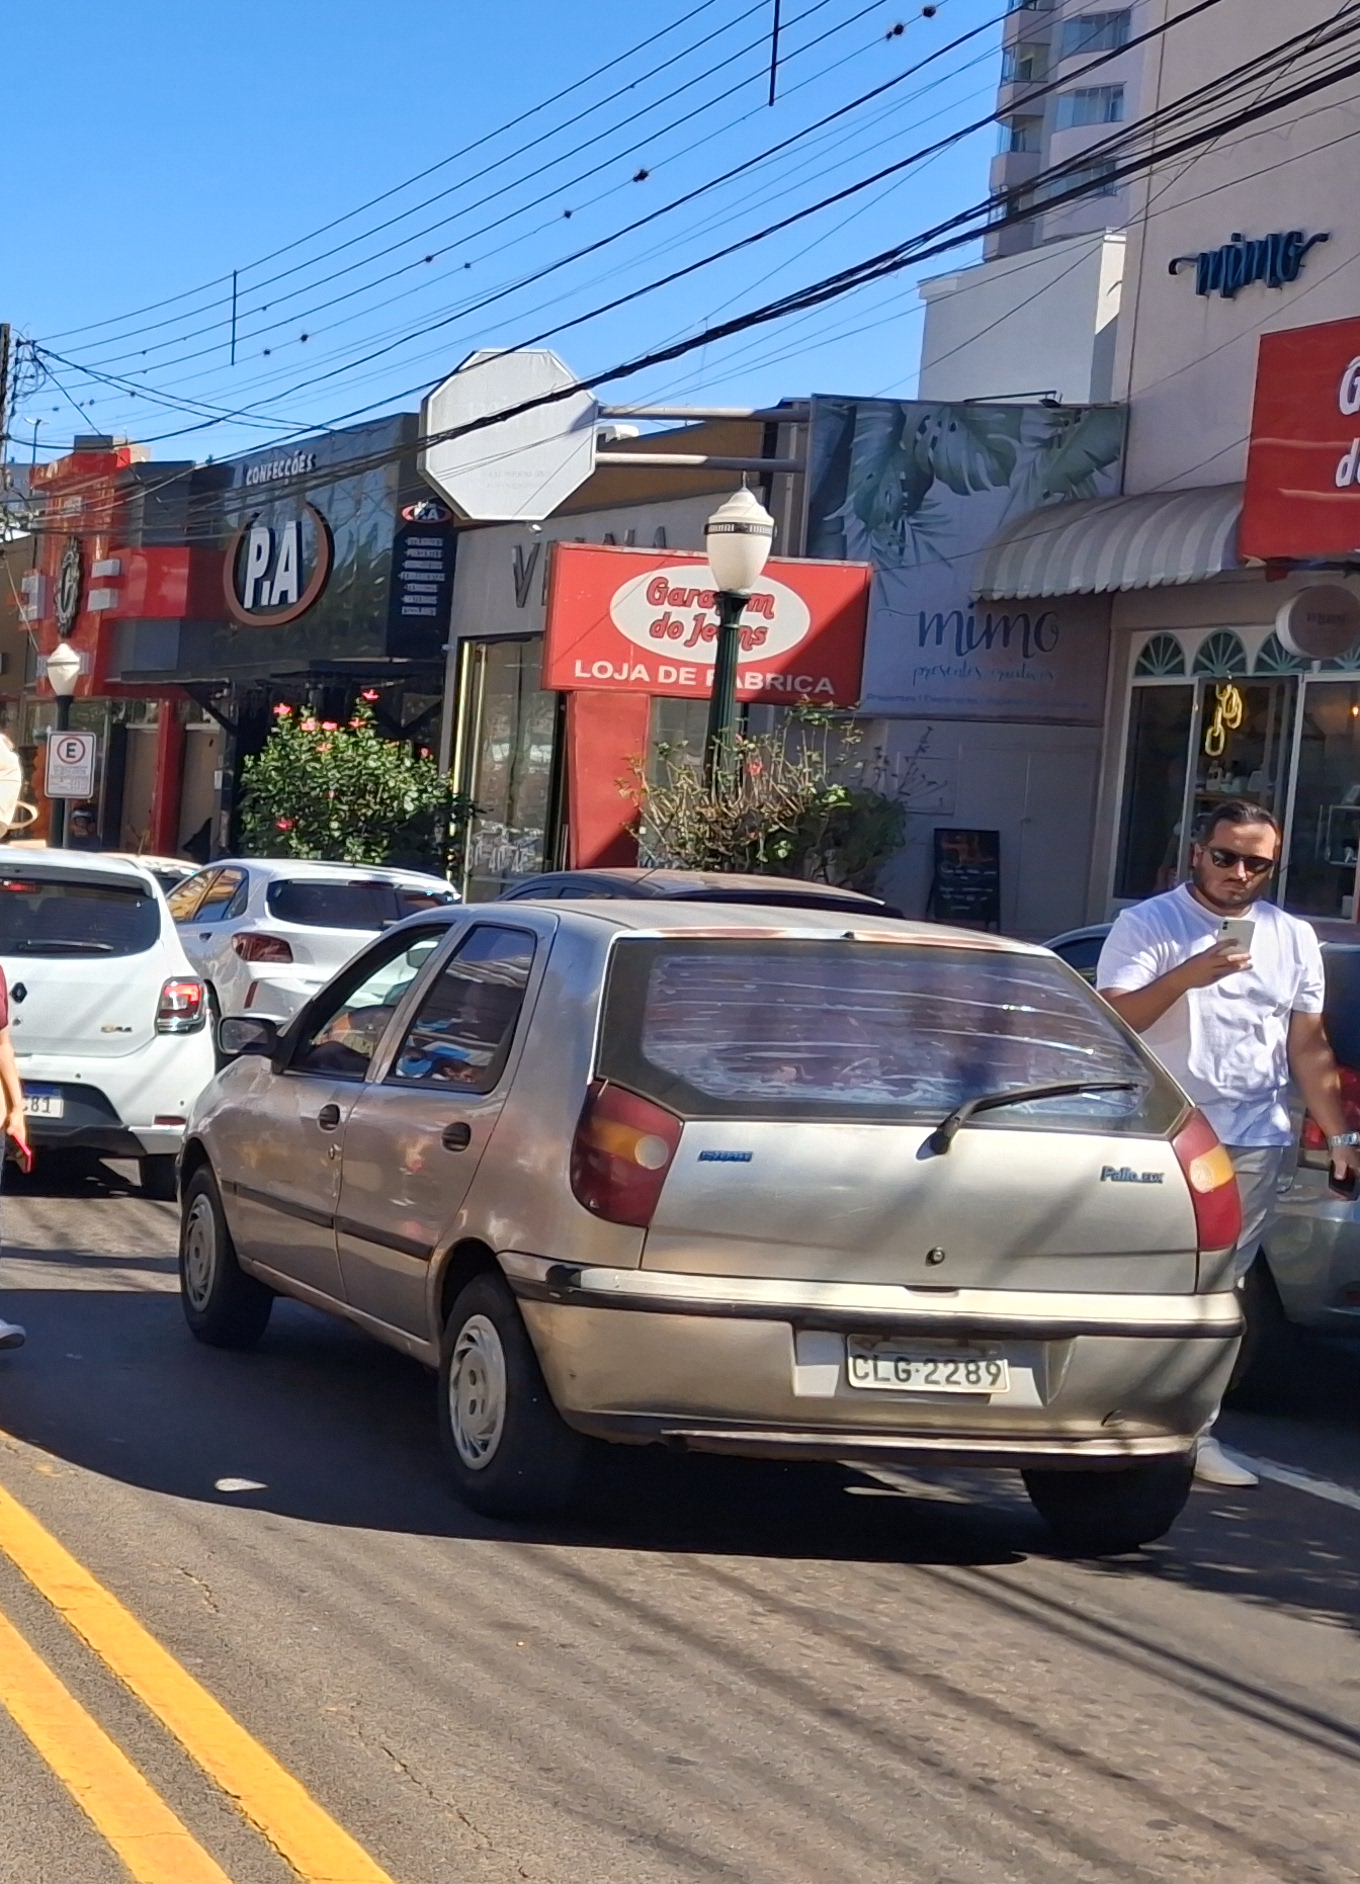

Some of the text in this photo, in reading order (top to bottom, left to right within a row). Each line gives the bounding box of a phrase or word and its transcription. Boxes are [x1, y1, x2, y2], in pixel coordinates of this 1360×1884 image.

[647, 576, 775, 620] Garam
[649, 611, 769, 652] do Jens
[917, 602, 1060, 659] mimo
[574, 659, 651, 684] LOJA
[657, 666, 697, 686] DE
[66, 742, 77, 758] E
